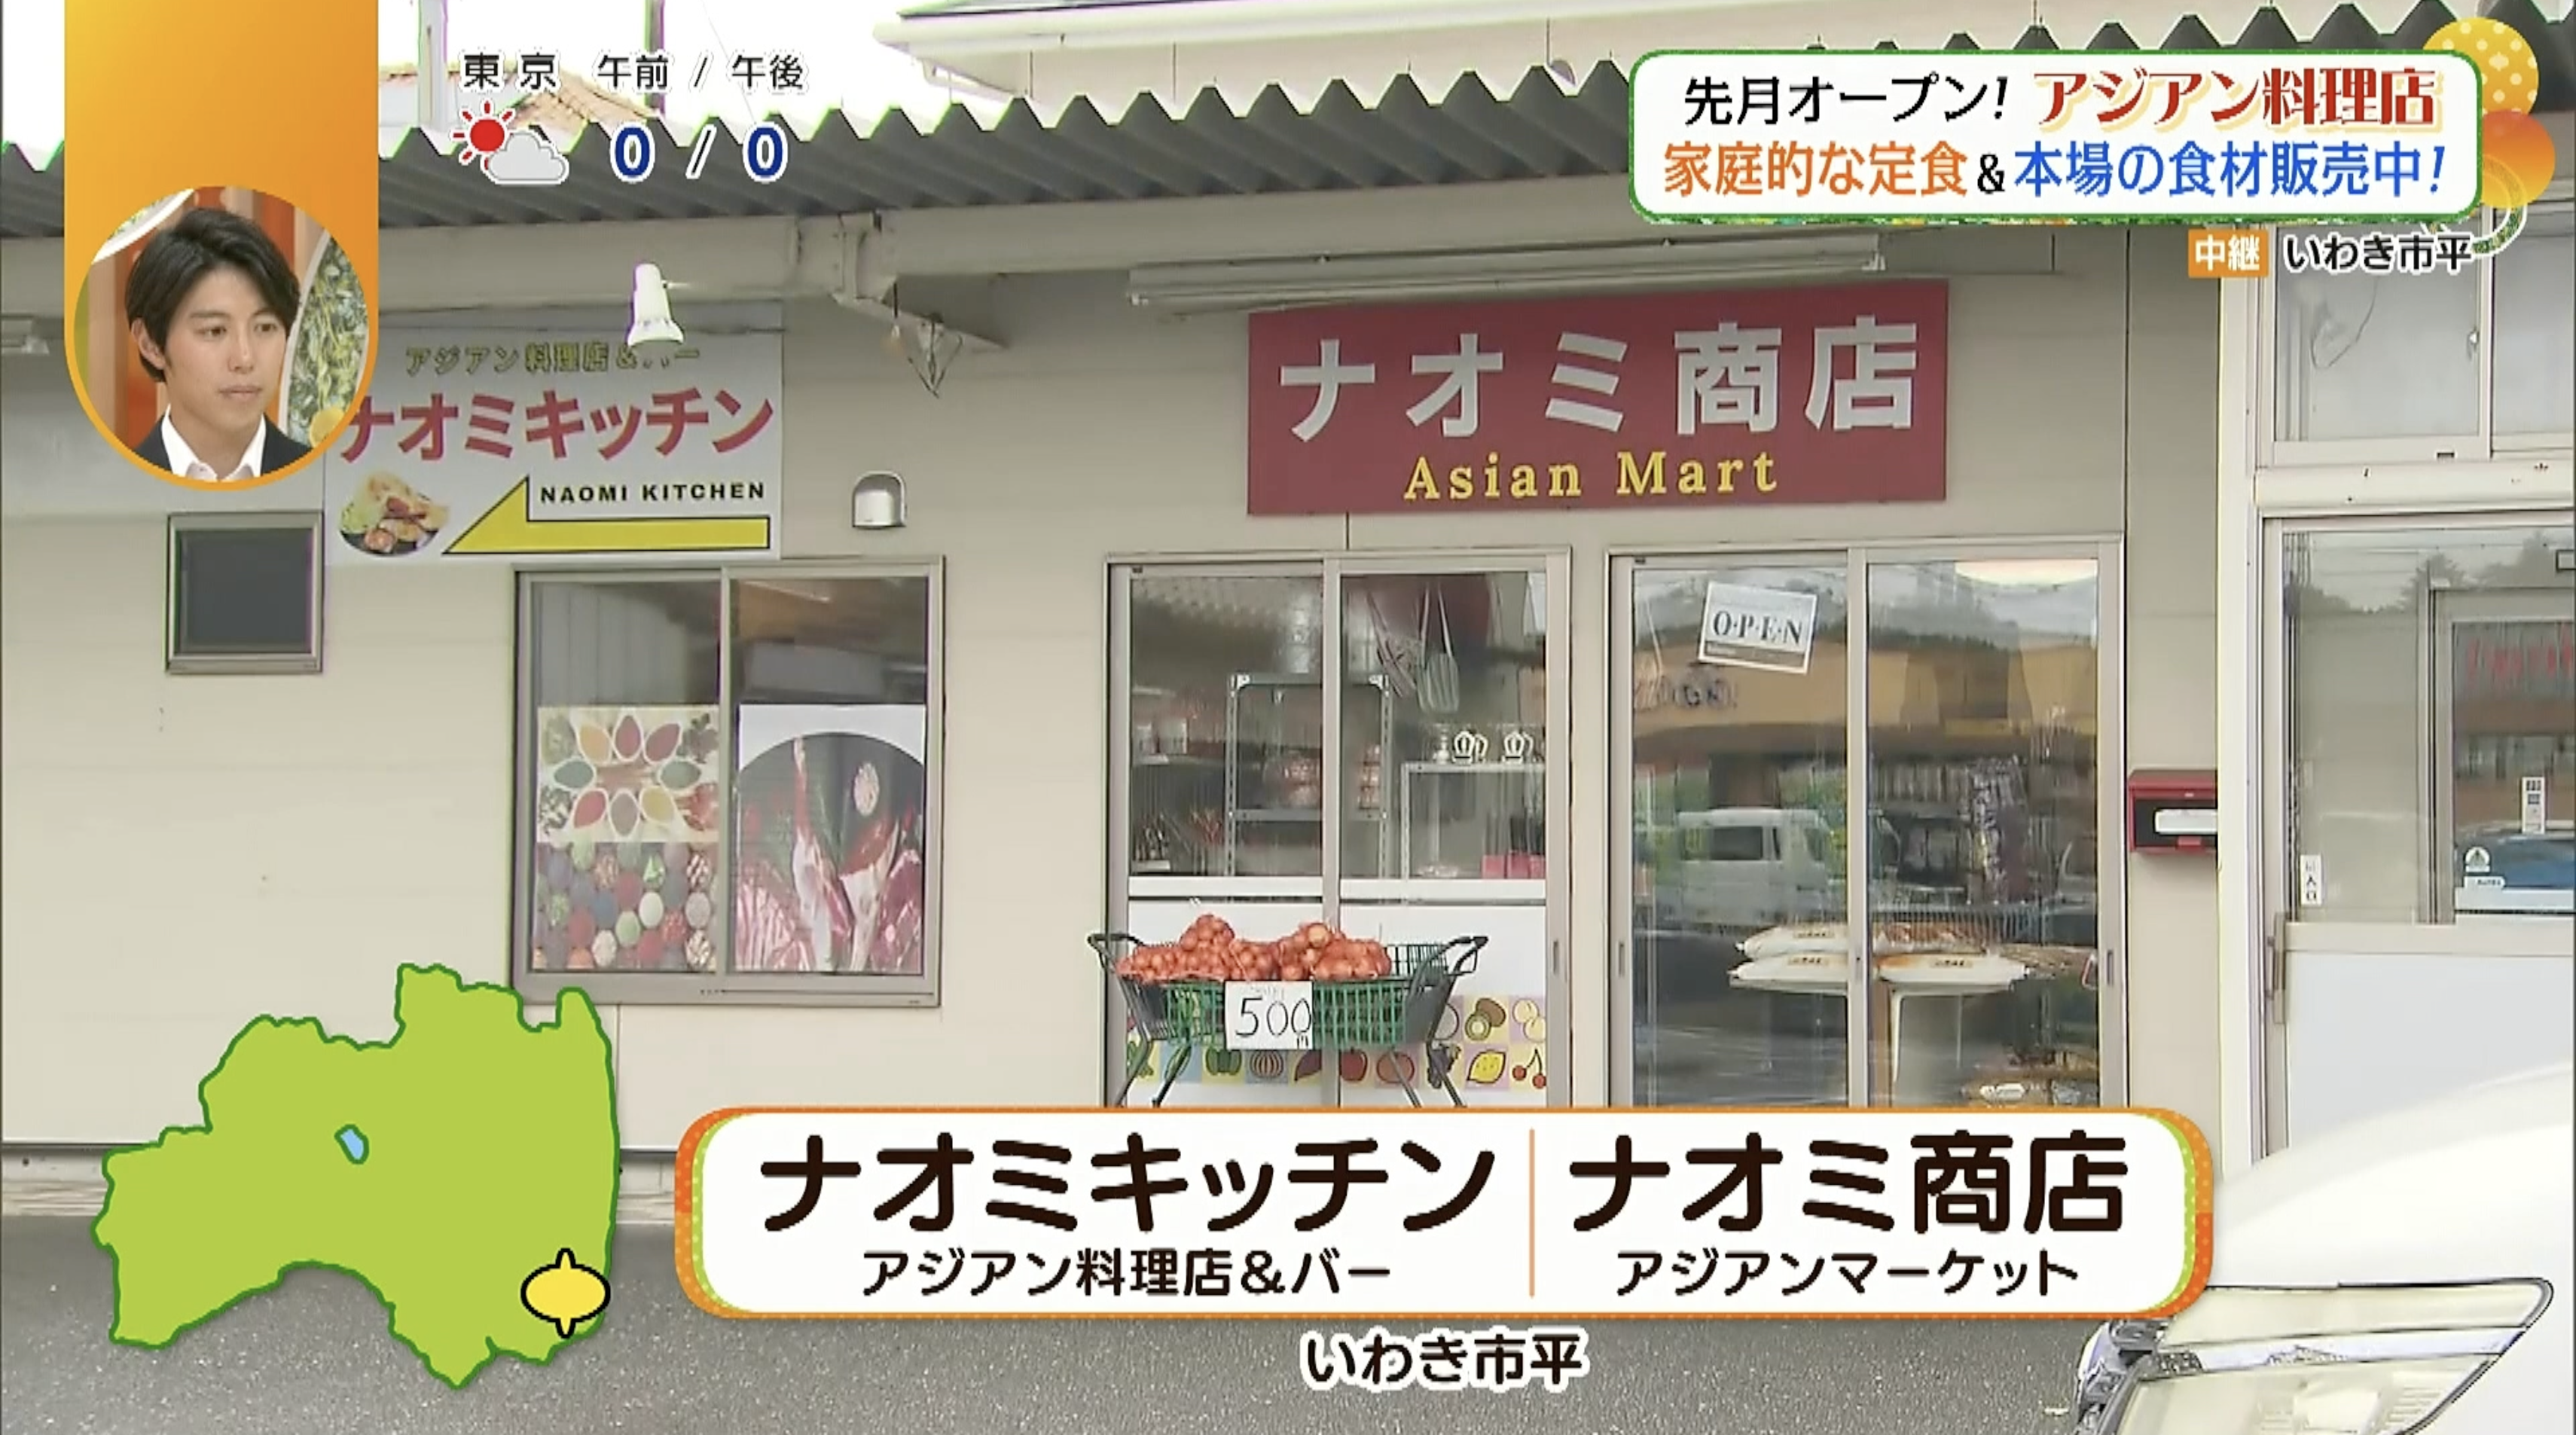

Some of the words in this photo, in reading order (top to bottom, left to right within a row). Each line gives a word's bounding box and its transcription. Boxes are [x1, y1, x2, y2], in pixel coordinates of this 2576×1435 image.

[1279, 315, 1918, 443] ナオミ商店
[340, 386, 774, 463] ナオミキッチン
[540, 484, 628, 502] NAOMI
[641, 481, 766, 502] KITCHEN
[1403, 455, 1582, 500] Asian
[1616, 450, 1778, 496] Mart
[1235, 994, 1312, 1037] 500
